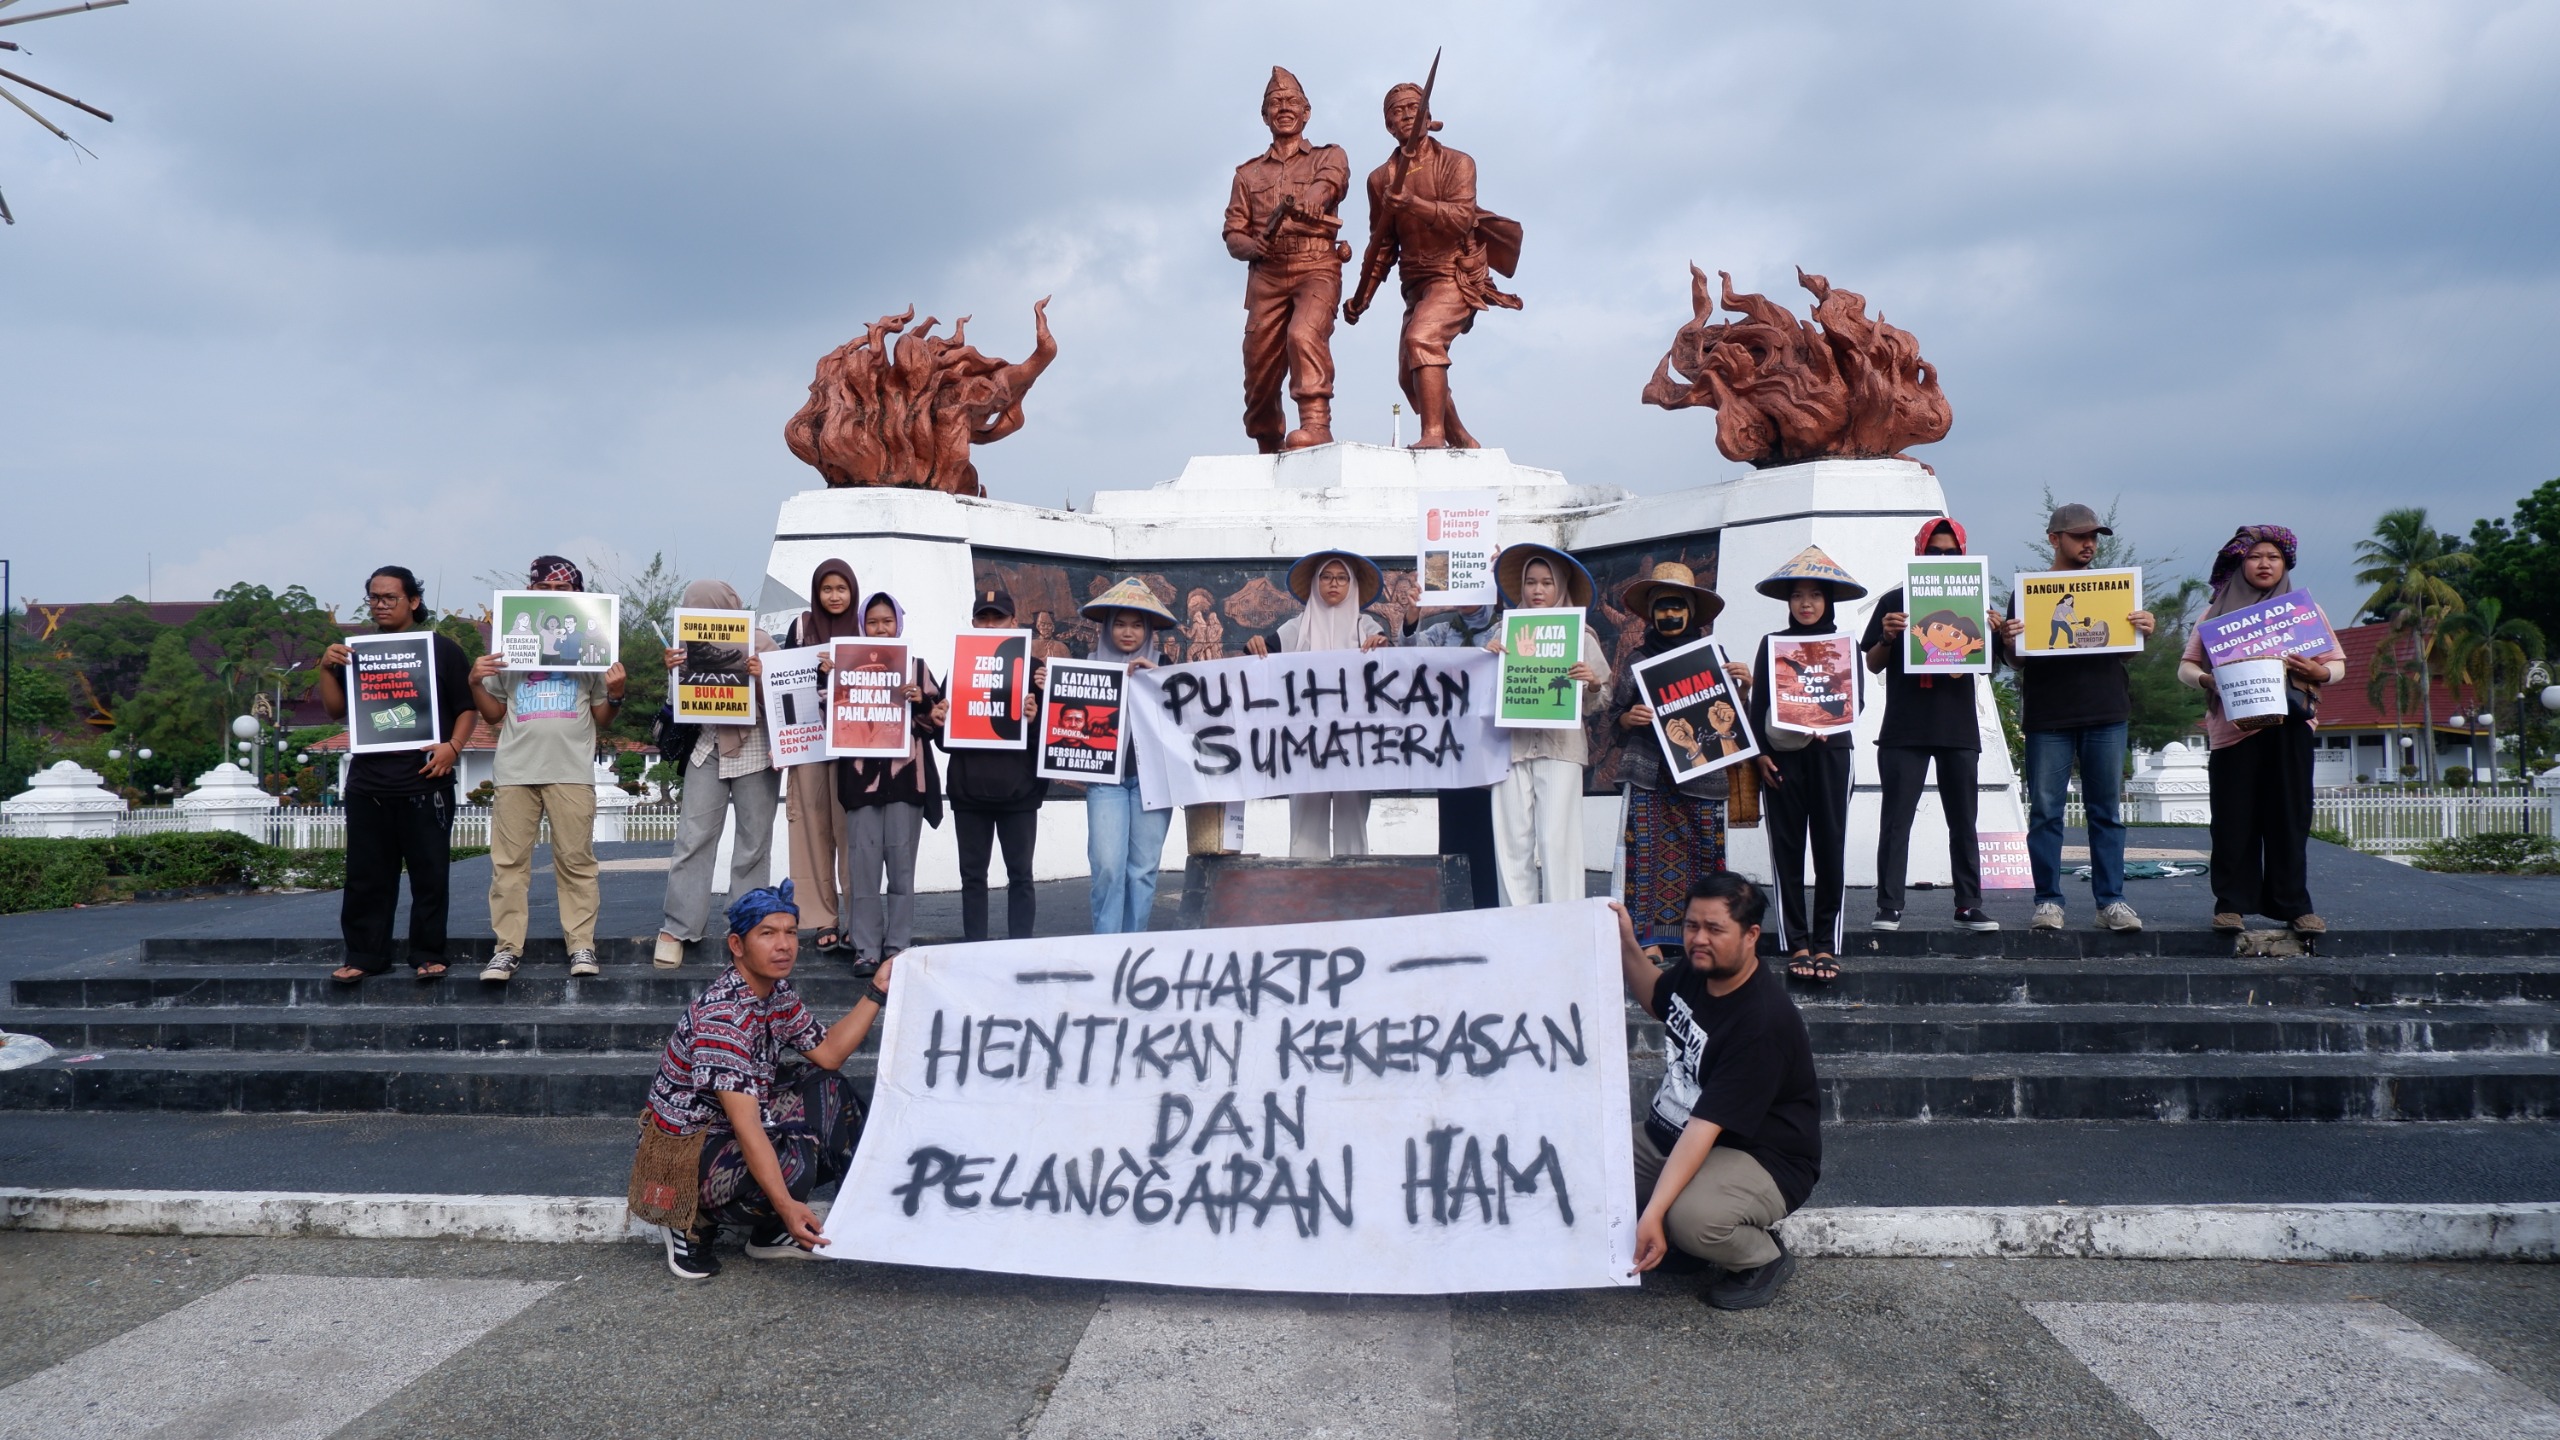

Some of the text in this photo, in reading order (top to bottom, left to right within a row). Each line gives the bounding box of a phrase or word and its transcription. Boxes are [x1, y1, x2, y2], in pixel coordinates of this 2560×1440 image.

[1443, 509, 1490, 518] Tumbler
[1443, 520, 1479, 529] Hilang
[1443, 530, 1479, 538] Heboh
[1452, 561, 1487, 570] Hilang
[1452, 580, 1485, 589] Diam?
[1911, 575, 1980, 584] MASIH ADAKAH
[1912, 586, 1979, 596] RUANG AMAN?
[2026, 580, 2130, 594] BANGUN KESETARAAN
[2218, 602, 2296, 636] TIDAK ADA
[684, 623, 745, 632] SURGA DIBAWAH
[1536, 625, 1566, 640] KATA
[2209, 610, 2317, 654] KEADILAN EKOLOGIS
[1535, 642, 1565, 657] LUCU
[2243, 632, 2294, 655] TANPA
[2281, 638, 2325, 657] GENDER
[385, 652, 416, 661] Lapor
[360, 660, 422, 671] Kekerasan?
[975, 656, 1004, 671] ZERO
[1507, 665, 1570, 673] Perkebuna
[1804, 665, 1823, 673] All
[360, 671, 409, 682] Upgrade
[688, 672, 740, 684] HAM
[770, 667, 817, 679] ANGGARAN
[840, 671, 901, 687] SOEHARTO
[1506, 675, 1537, 683] Sawit
[361, 680, 413, 690] Premium
[972, 674, 1004, 688] EMISI
[1062, 672, 1111, 687] KATANYA
[1798, 675, 1830, 685] Eyes
[2222, 681, 2248, 690] DONASI
[695, 687, 734, 699] BUKAN
[1054, 684, 1118, 700] DEMOKRASI
[1506, 686, 1545, 694] Adalah
[1658, 670, 1715, 704] LAWAN
[1804, 685, 1824, 693] On
[2233, 687, 2271, 697] BENCANA
[362, 690, 418, 700] Dulu Wak
[850, 689, 891, 704] BUKAN
[1657, 682, 1726, 716] KRIMINALISASI
[1782, 693, 1847, 703] Sumatera
[682, 701, 748, 711] DI KAKI APARAT
[2232, 696, 2275, 707] SUMATERA
[838, 706, 902, 722] PAHLAWAN
[968, 701, 1004, 717] HOAX!
[779, 725, 825, 737] ANGGARA
[780, 734, 823, 746] BENCANA
[781, 746, 798, 754] 500
[1048, 746, 1113, 761] BERSUARA KOK
[1193, 718, 1465, 779] SUMATERA
[1056, 758, 1103, 770] DI BATASI?
[923, 1002, 1588, 1090] HENTIKAN KEKERASAN
[1148, 1086, 1306, 1160] DAN
[892, 1124, 1574, 1238] PELANGGARAN HAM
